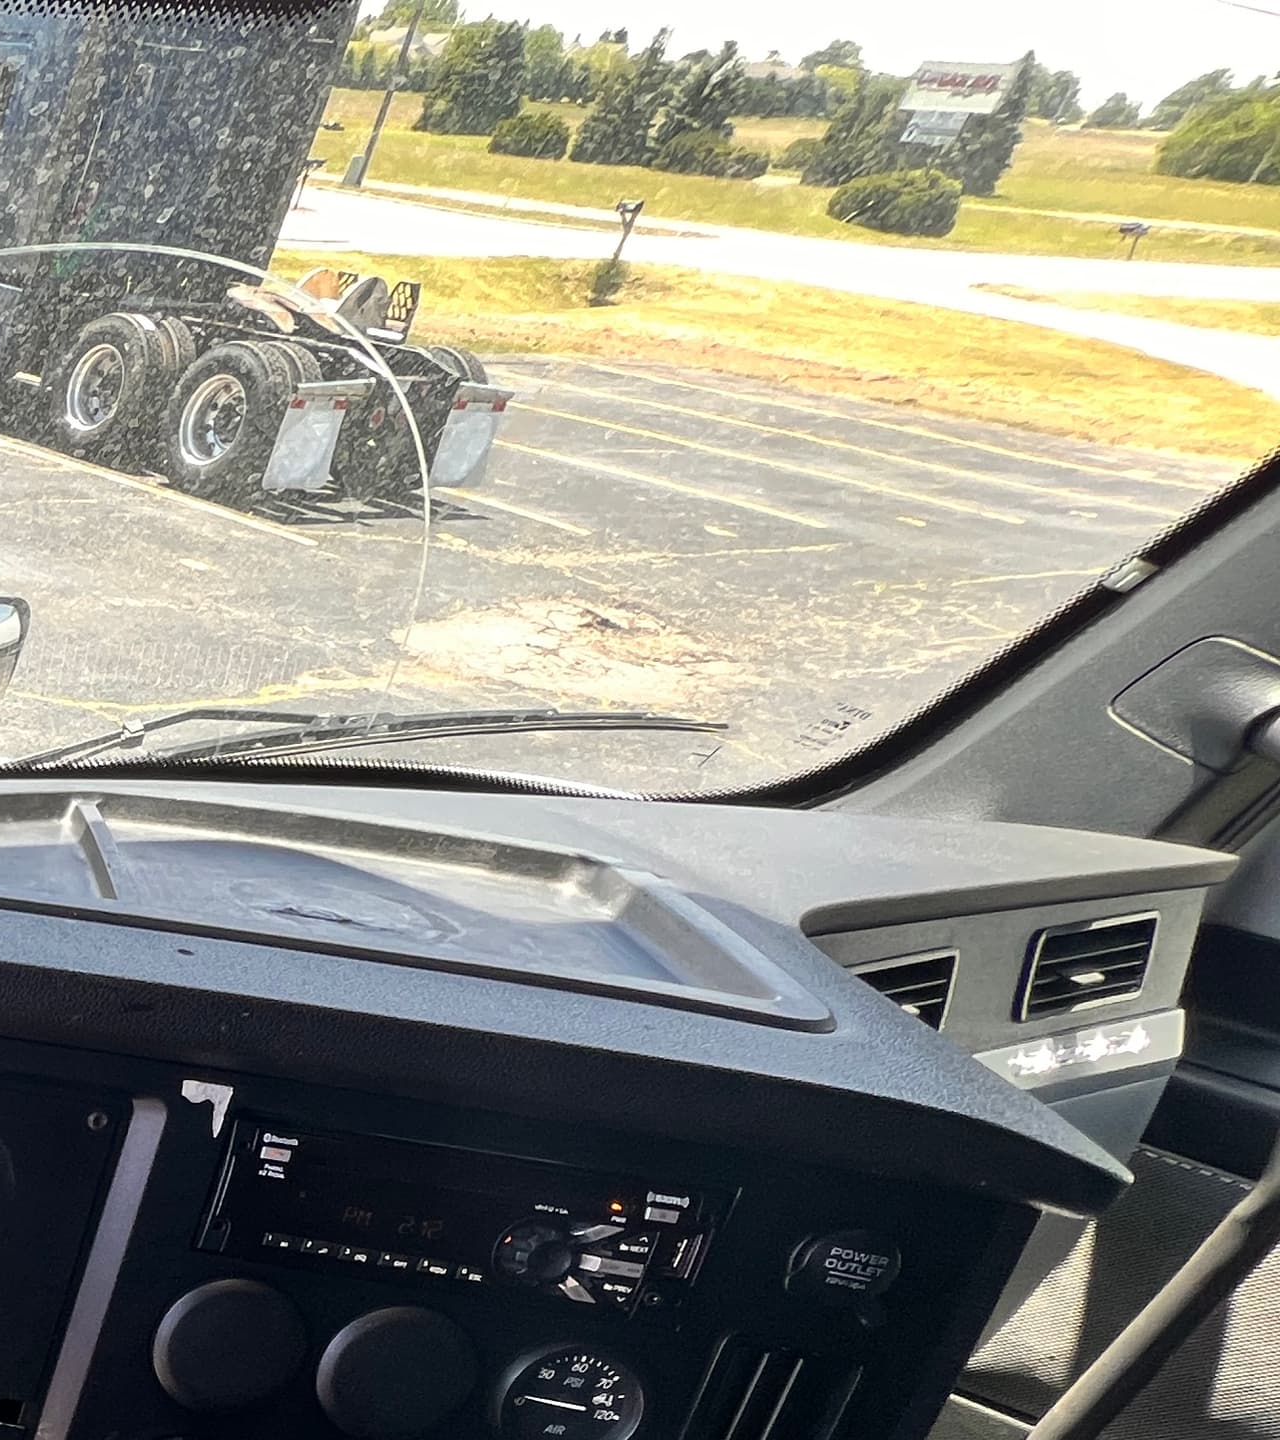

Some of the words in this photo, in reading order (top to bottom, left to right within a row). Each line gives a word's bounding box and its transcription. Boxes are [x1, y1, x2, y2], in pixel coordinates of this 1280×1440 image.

[830, 1246, 889, 1265] POWER
[824, 1258, 885, 1277] OUTLET
[571, 1362, 589, 1373] 60
[563, 1376, 585, 1388] PSI
[595, 1378, 613, 1389] 70
[594, 1409, 613, 1421] 120
[543, 1424, 567, 1436] AIR
